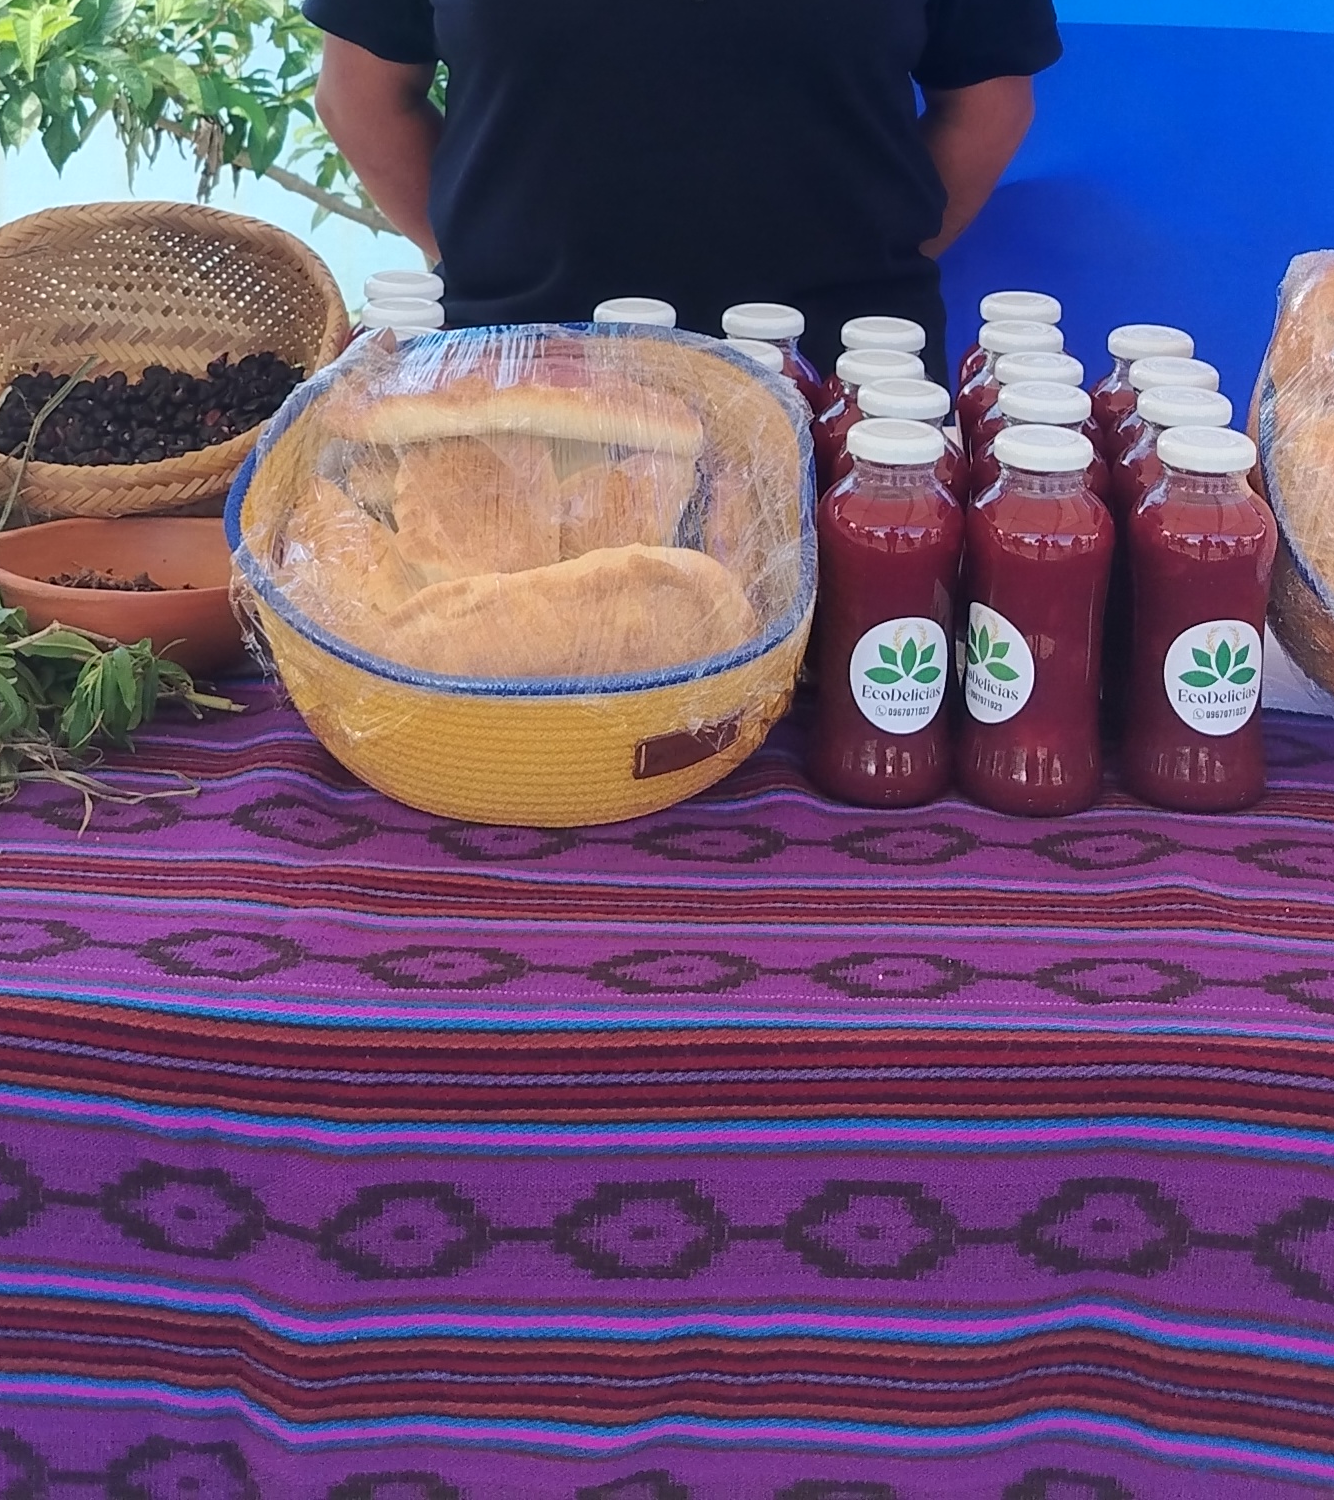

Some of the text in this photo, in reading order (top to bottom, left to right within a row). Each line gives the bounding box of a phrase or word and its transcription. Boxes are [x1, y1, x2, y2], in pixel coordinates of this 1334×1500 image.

[862, 684, 942, 702] EcoDelicias
[1178, 685, 1257, 705] EcoDelicias
[888, 706, 930, 717] 0967071023
[1205, 706, 1247, 719] 0967071023
